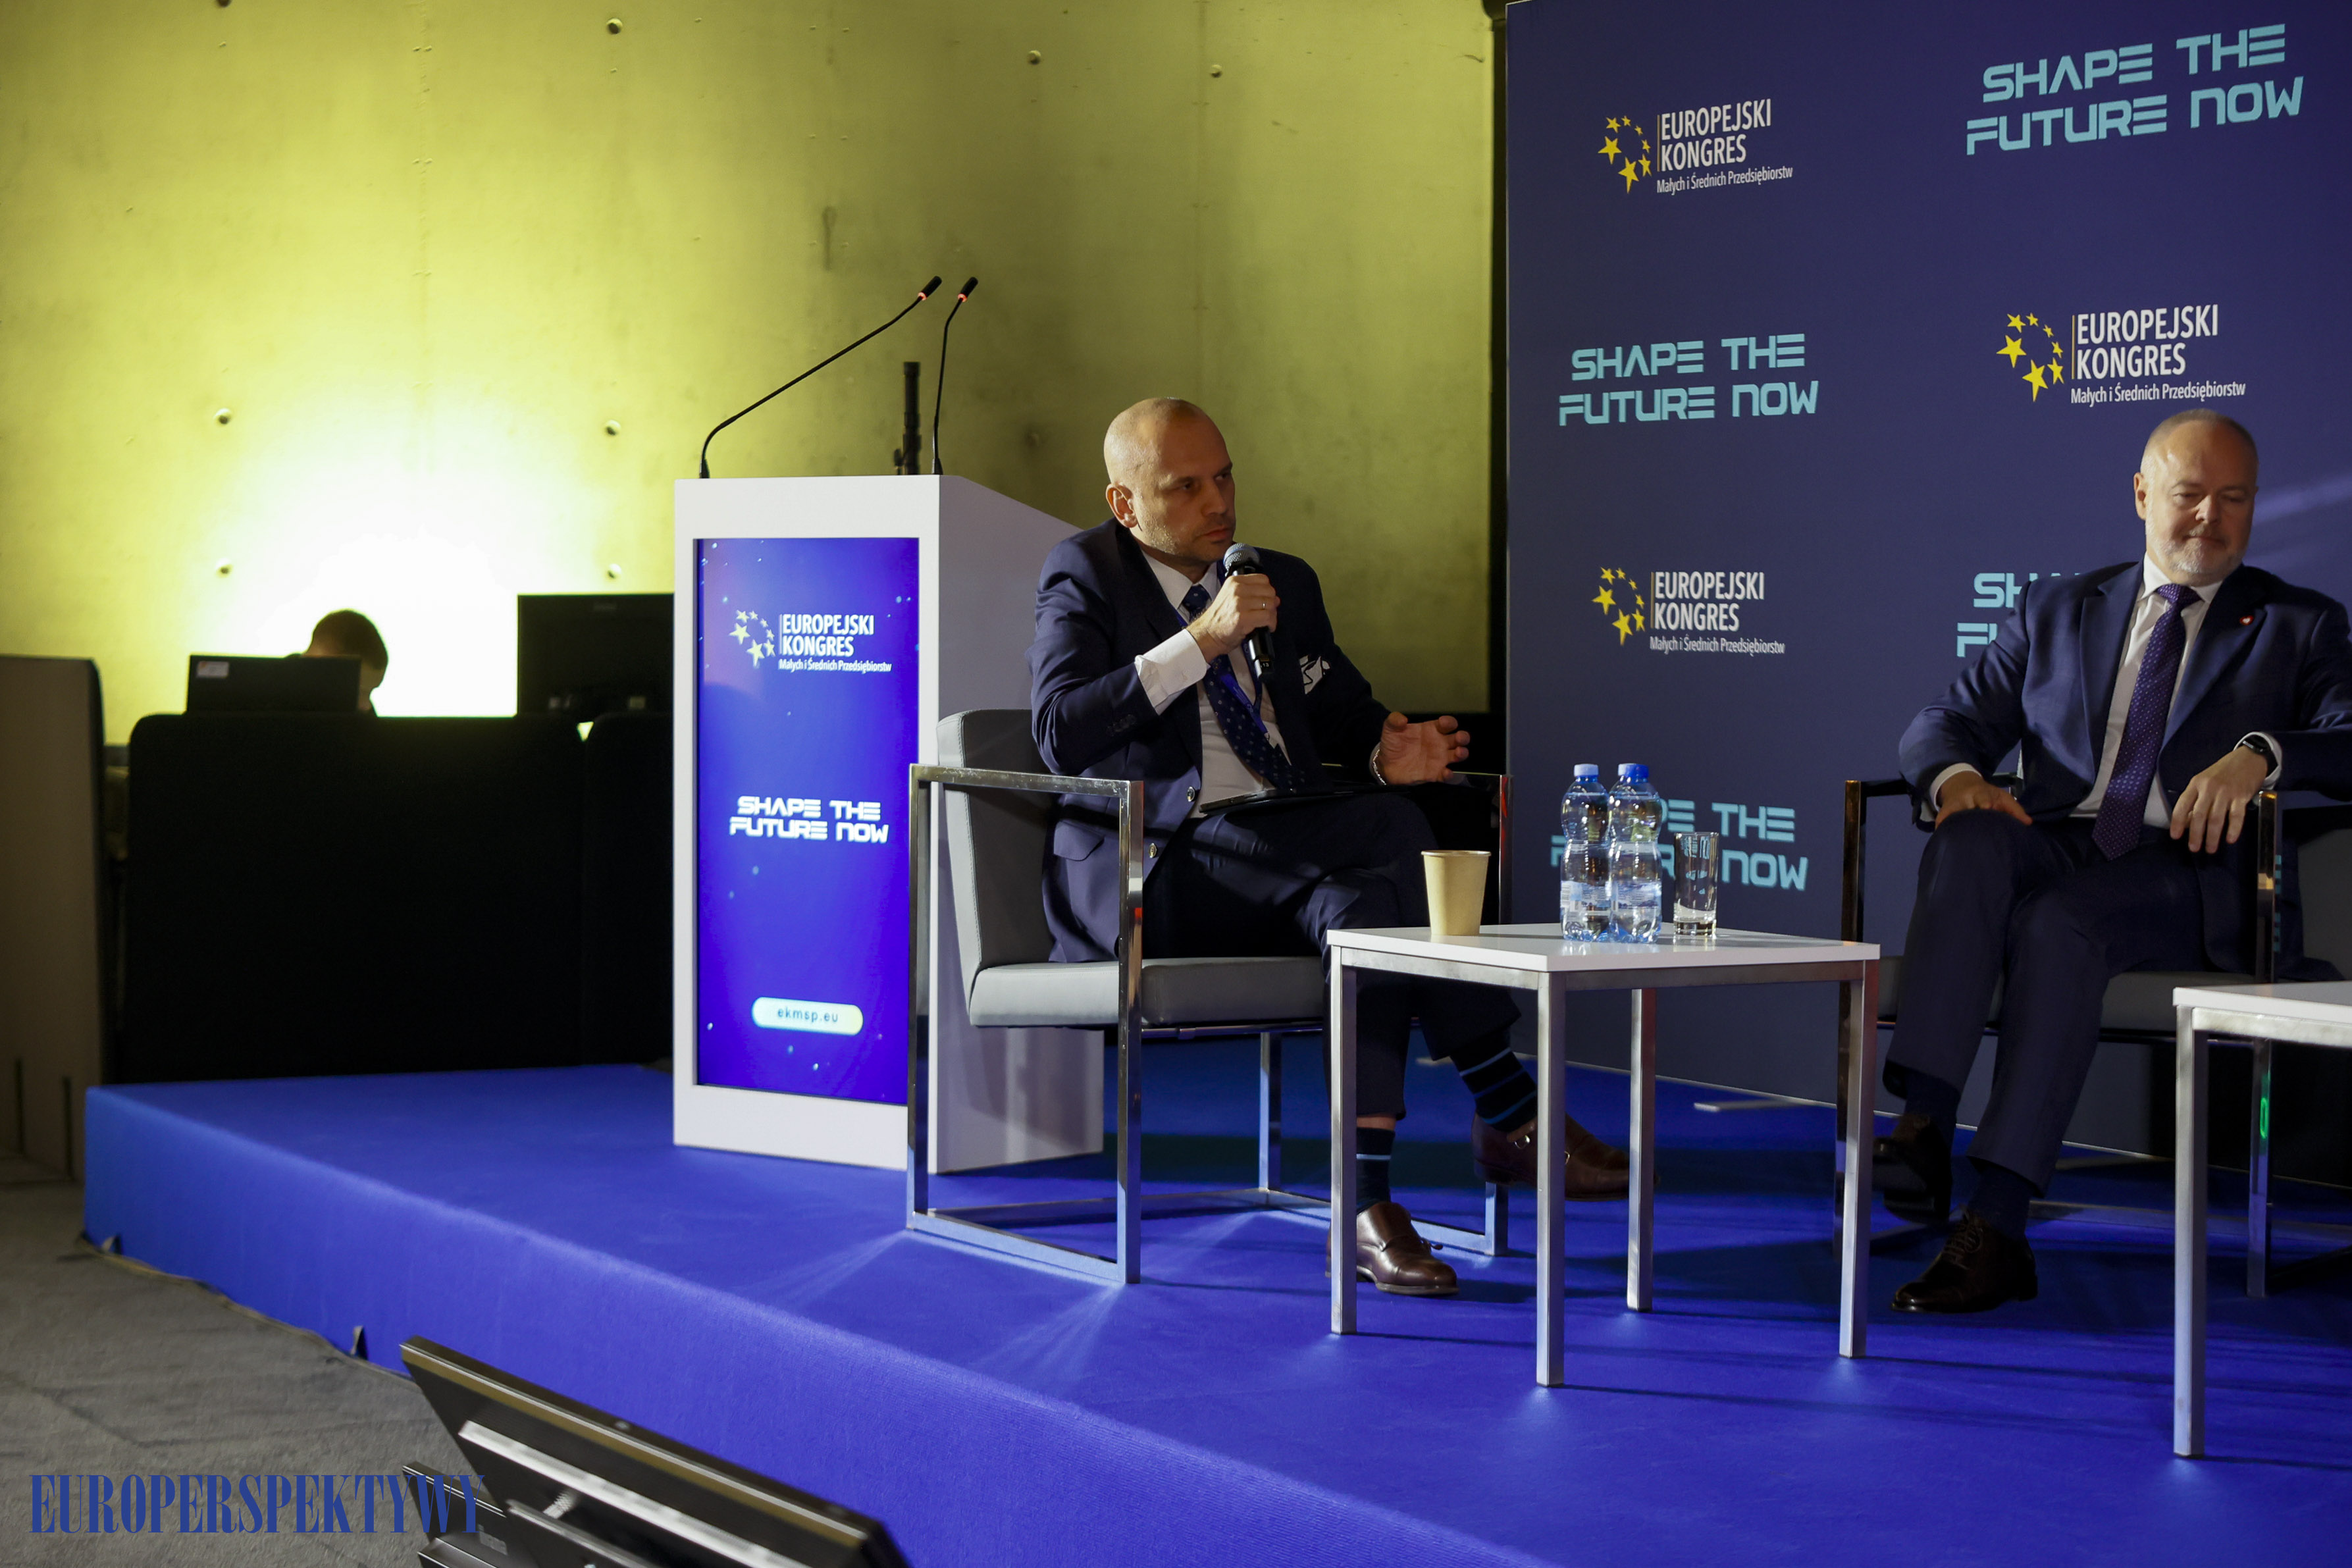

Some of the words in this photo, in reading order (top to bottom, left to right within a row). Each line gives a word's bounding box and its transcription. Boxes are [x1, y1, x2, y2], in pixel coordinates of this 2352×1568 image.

[1983, 43, 2153, 103] SHAPE
[2176, 24, 2286, 75] THE
[1661, 98, 1771, 140] EUROPEJSKI
[1966, 94, 2167, 155] FUTURE
[2190, 76, 2304, 128] NOW
[1661, 134, 1746, 172] KONGRES
[1656, 176, 1685, 196] Małych
[1690, 171, 1727, 190] Średnich
[1728, 165, 1793, 185] Przedsiębiorstw
[2077, 304, 2218, 345] EUROPEJSKI
[1571, 340, 1704, 381] SHAPE
[1721, 333, 1805, 371] THE
[2077, 342, 2186, 380] KONGRES
[1559, 386, 1715, 427] FUTURE
[1732, 380, 1819, 417] NOW
[2071, 386, 2107, 407] Małych
[2114, 382, 2160, 402] Średnich
[2162, 380, 2246, 402] Przedsiębiorstw
[1655, 571, 1765, 600] EUROPEJSKI
[782, 614, 874, 635] EUROPEJSKI
[1654, 602, 1740, 632] KONGRES
[782, 635, 854, 657] KONGRES
[737, 795, 821, 818] SHAPE
[829, 800, 881, 821] THE
[1712, 802, 1795, 842] THE
[729, 816, 828, 841] FUTURE
[836, 822, 889, 843] NOW
[1721, 849, 1809, 891] NOW
[777, 1006, 838, 1022] ekmsp.eu
